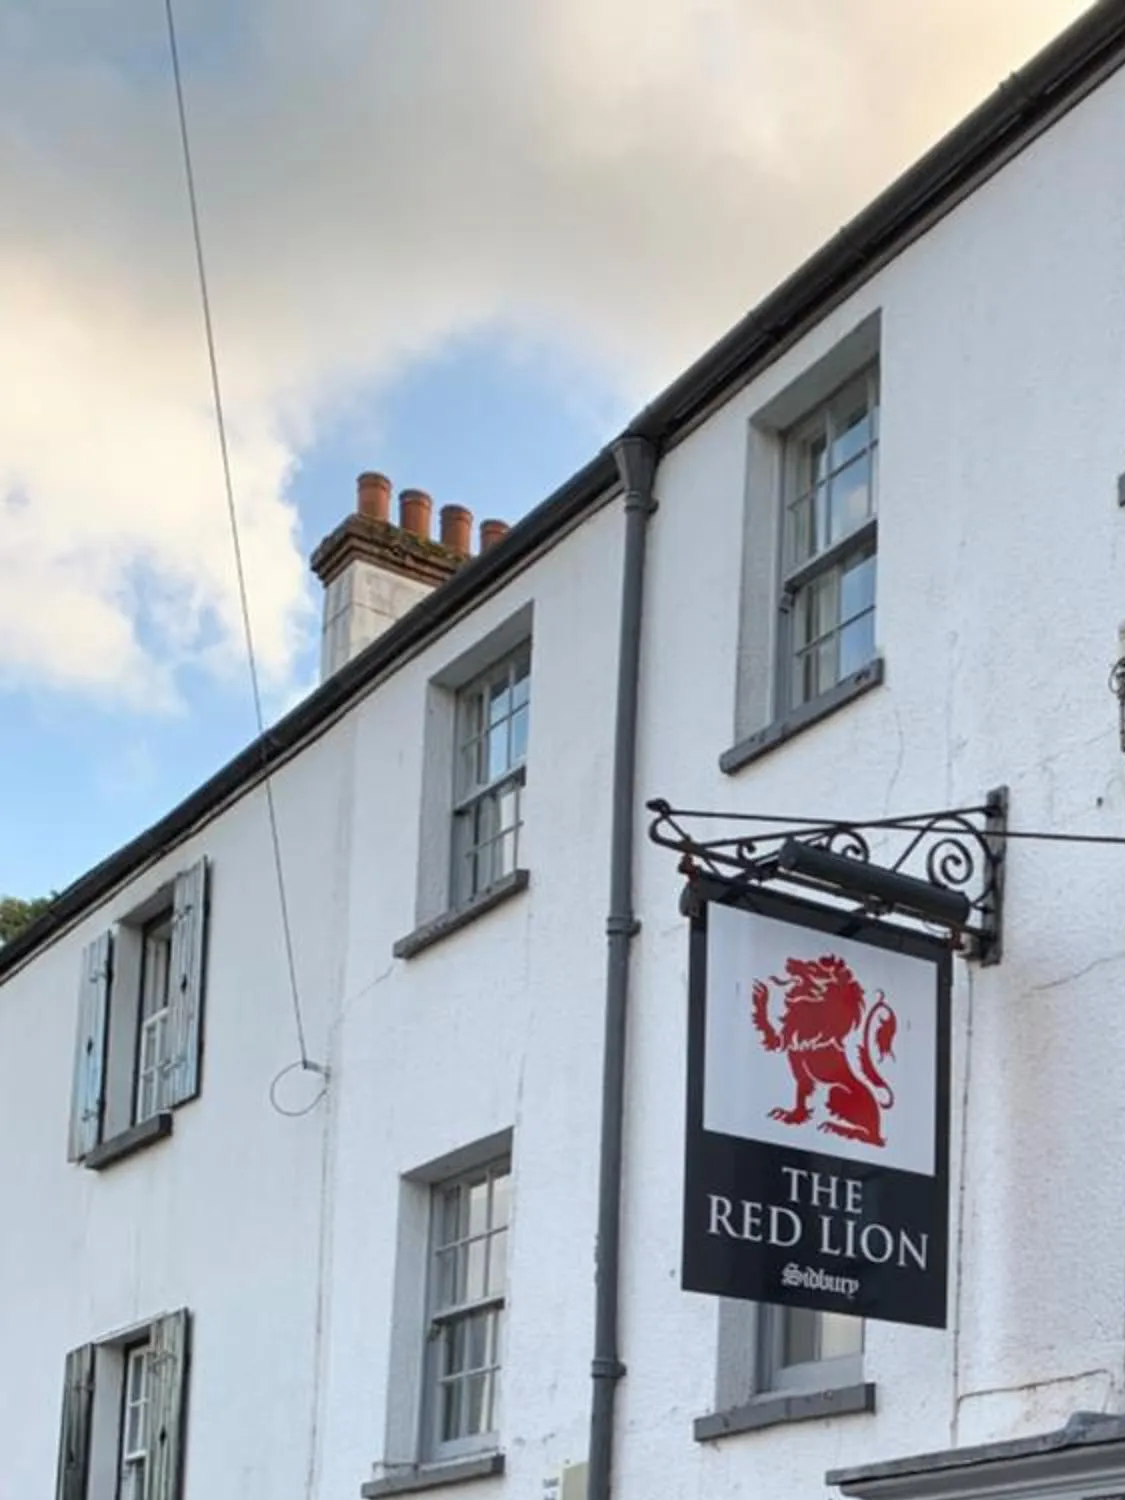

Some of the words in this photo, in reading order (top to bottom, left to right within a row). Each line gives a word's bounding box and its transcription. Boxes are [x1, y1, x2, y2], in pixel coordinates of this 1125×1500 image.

[781, 1166, 863, 1214] THE
[707, 1194, 803, 1247] RED
[819, 1214, 929, 1271] LION
[781, 1261, 860, 1299] Sidbury
